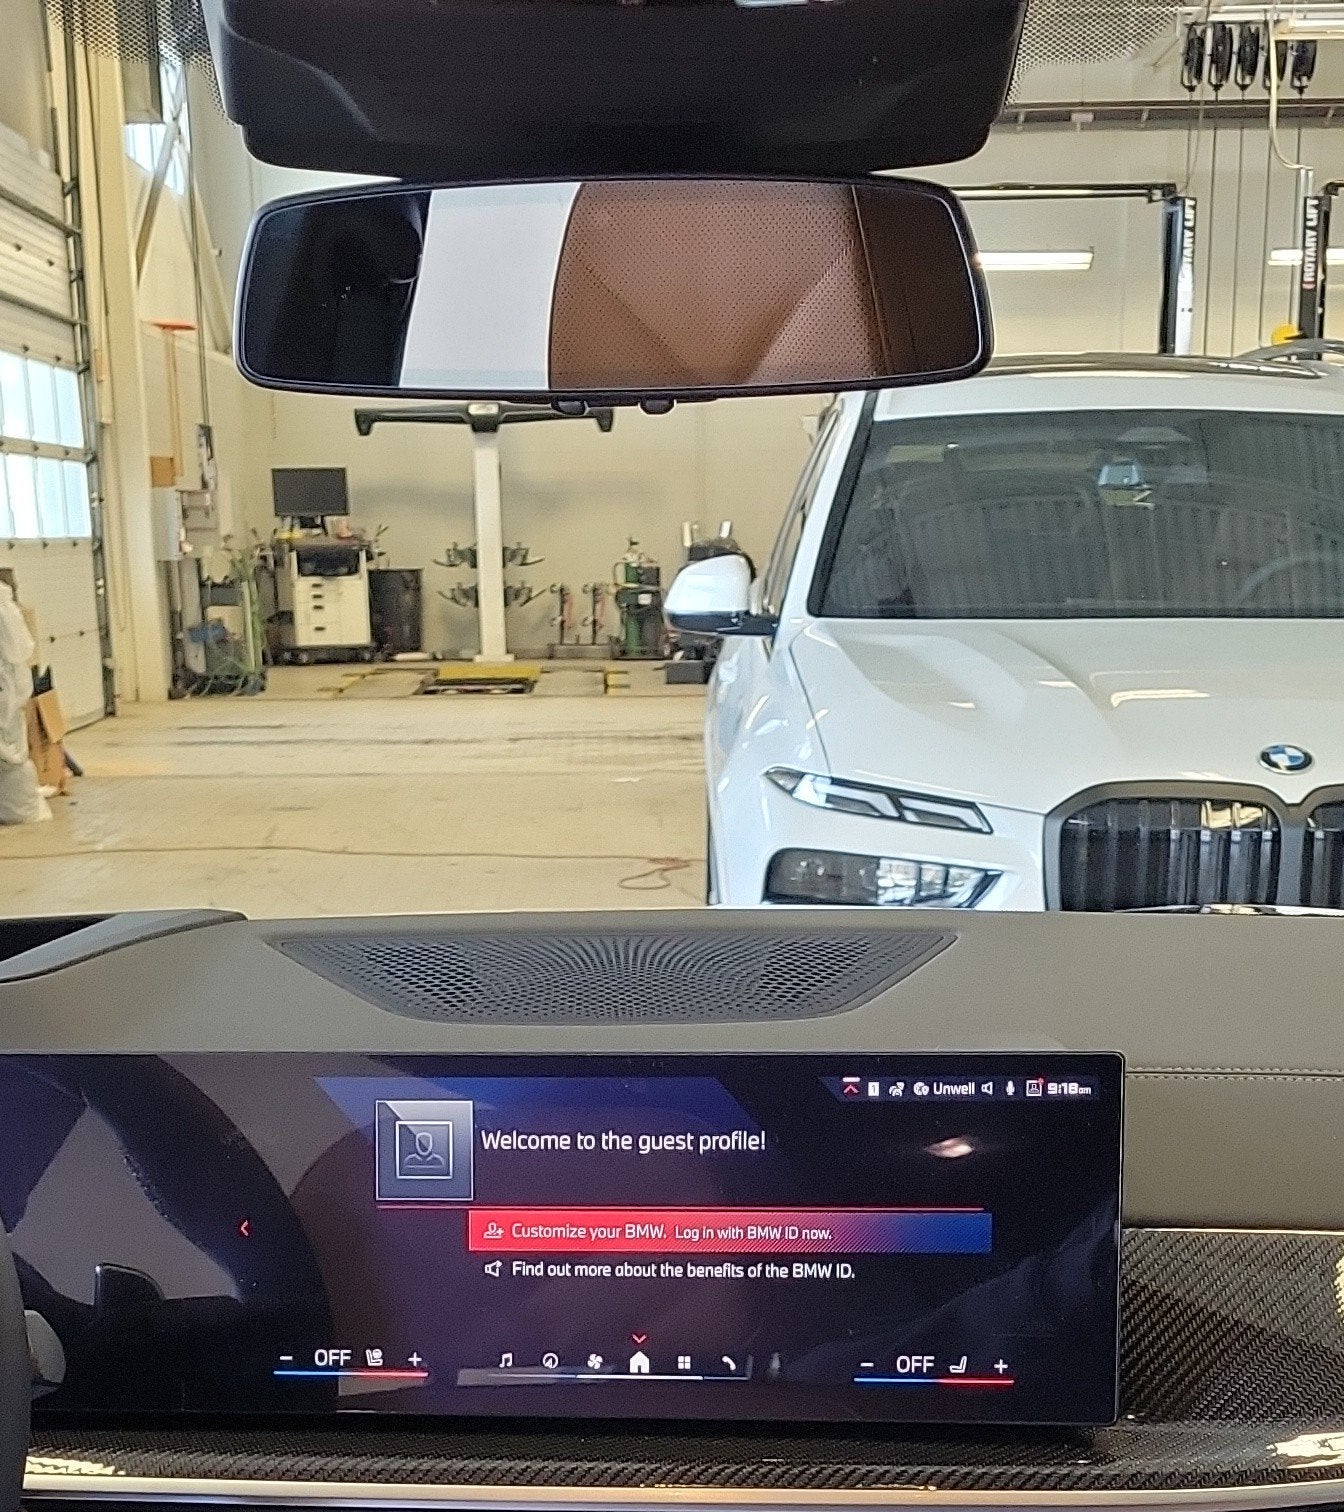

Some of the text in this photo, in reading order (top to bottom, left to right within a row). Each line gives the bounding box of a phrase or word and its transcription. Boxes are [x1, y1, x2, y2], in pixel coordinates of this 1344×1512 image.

[1306, 198, 1320, 226] LIFT
[933, 1081, 975, 1095] Unwell
[481, 1130, 766, 1154] Welcome to the guest profile!
[511, 1223, 832, 1242] Customize your BMW. Log in with BMW ID now.
[512, 1261, 855, 1279] Find out more about the benefits of the BMW ID.
[314, 1349, 352, 1366] OFF
[896, 1355, 935, 1373] OFF
